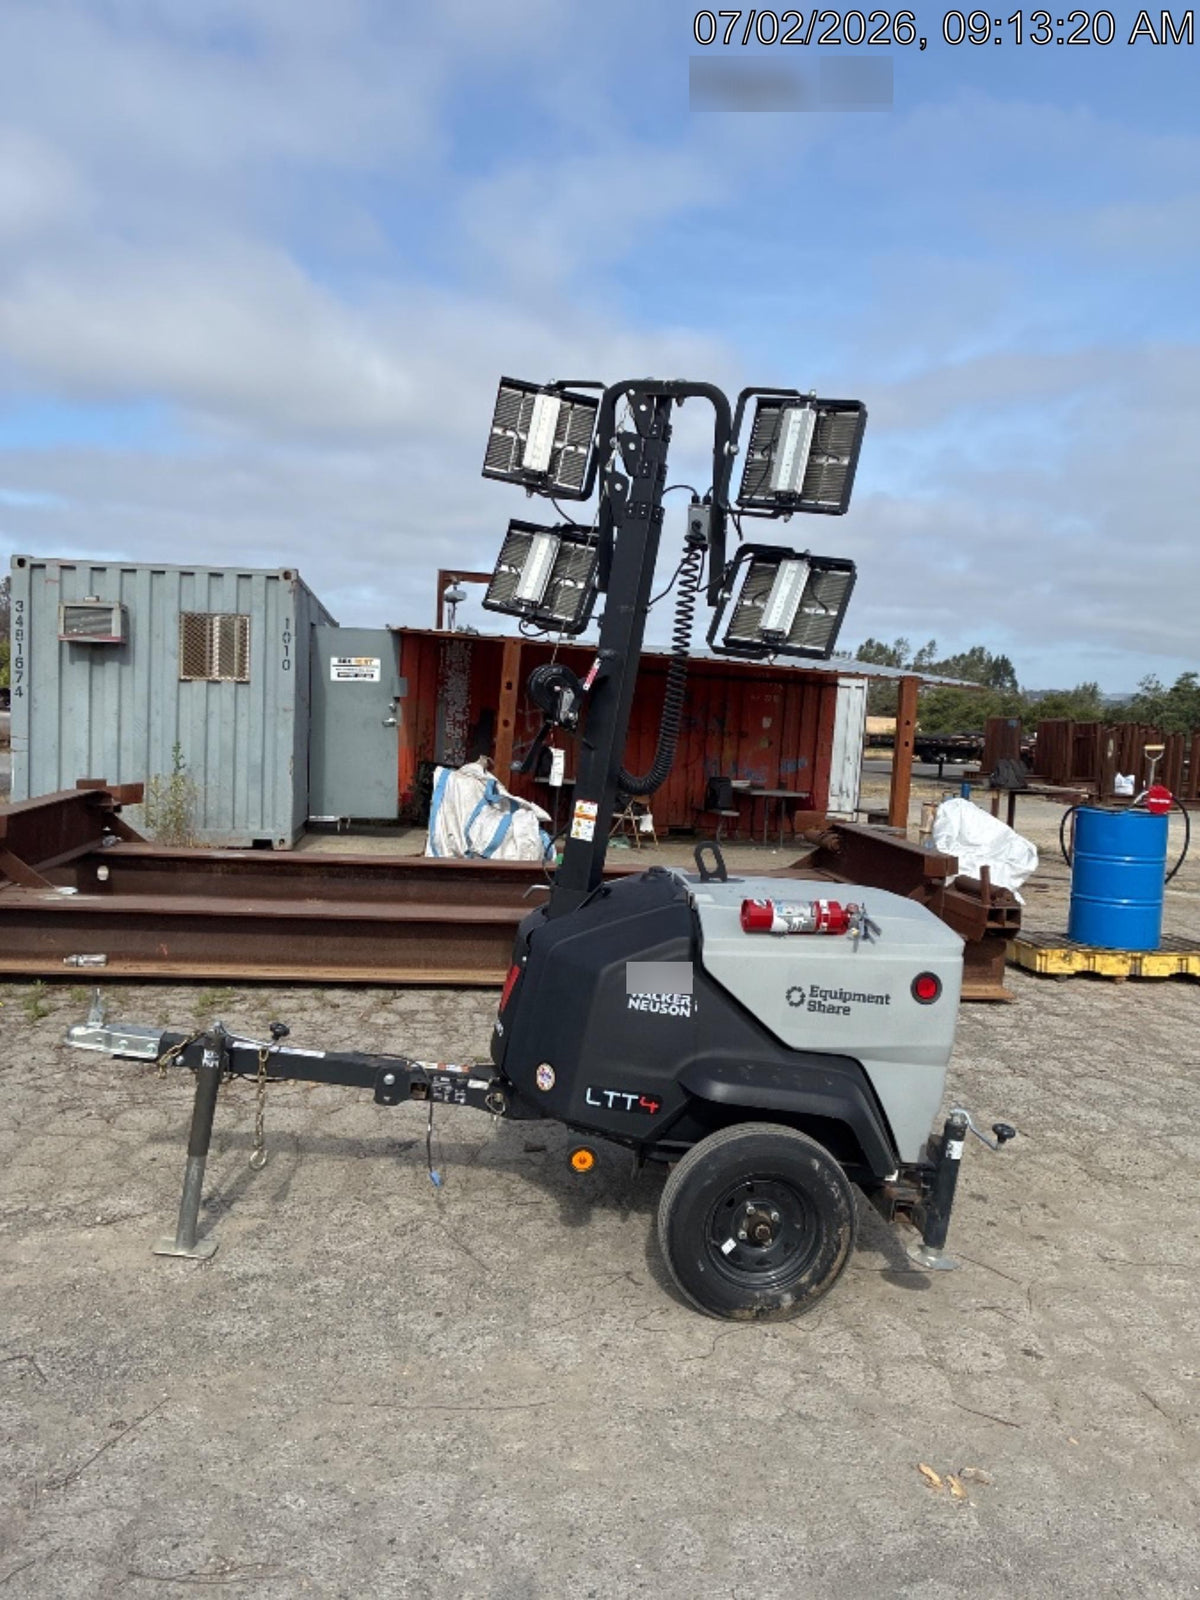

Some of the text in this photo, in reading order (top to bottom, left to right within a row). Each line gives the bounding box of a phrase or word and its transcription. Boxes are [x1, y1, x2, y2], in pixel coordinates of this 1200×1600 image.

[809, 984, 891, 1005] Equipment
[627, 998, 691, 1018] NEUSON
[807, 1000, 852, 1016] Share
[585, 1087, 659, 1114] LTT4
